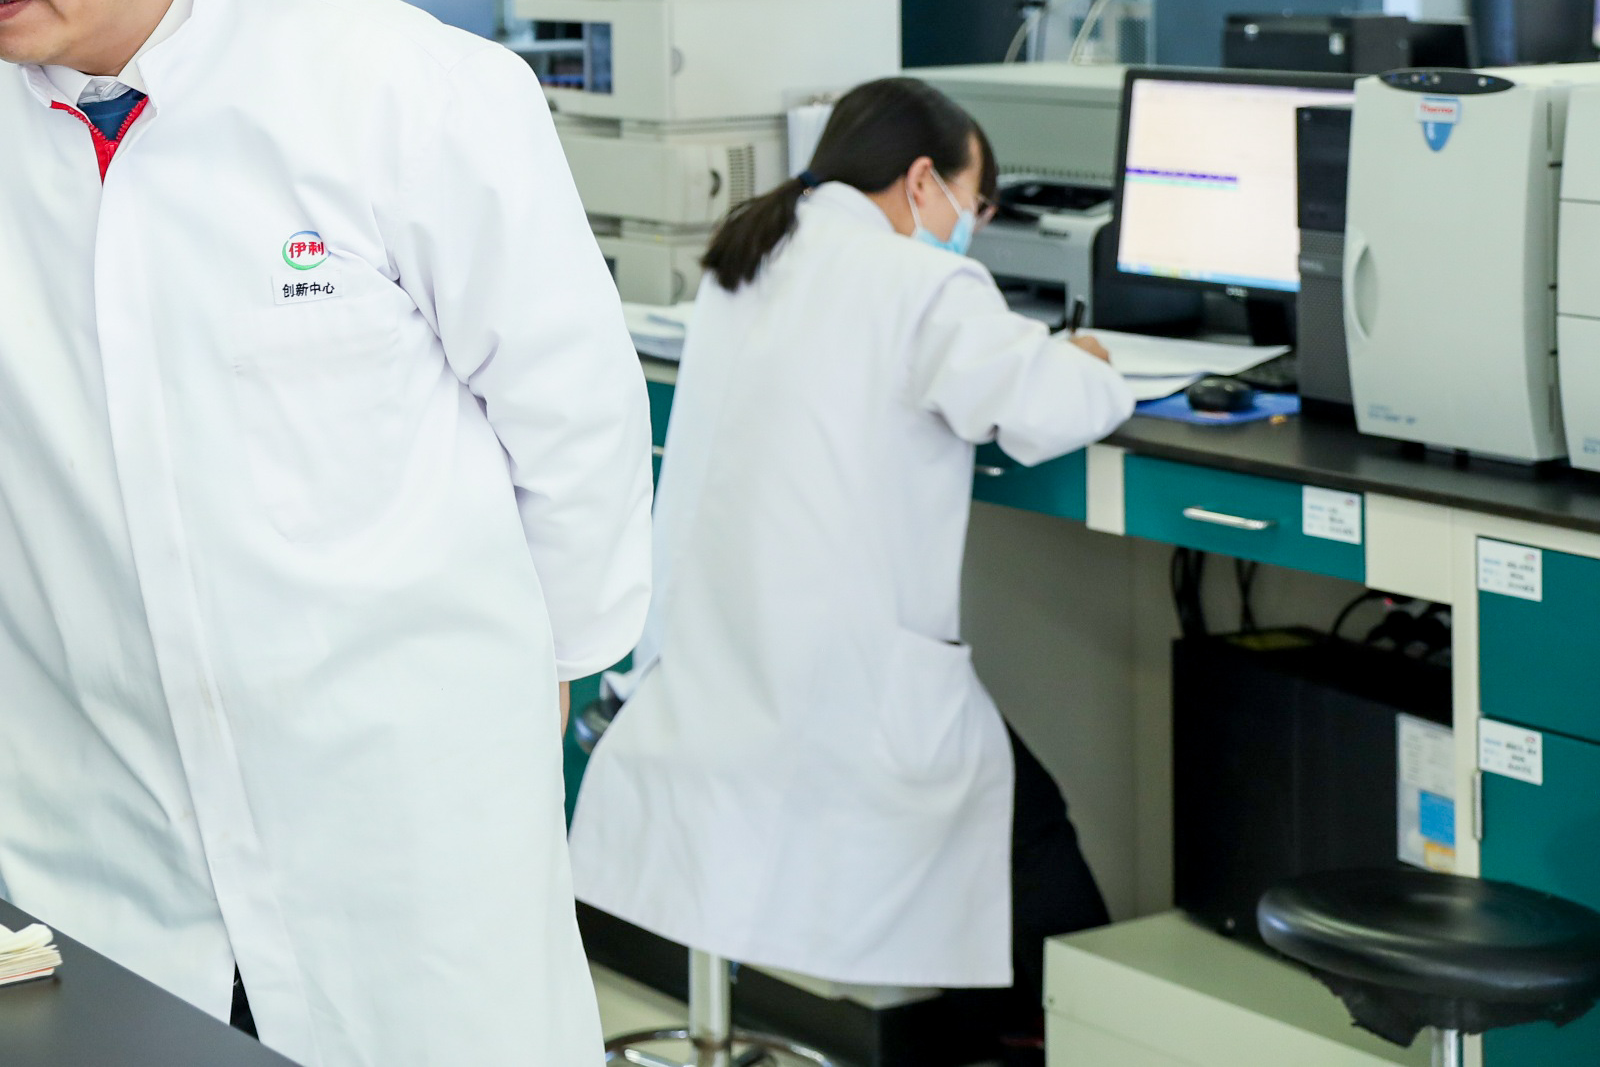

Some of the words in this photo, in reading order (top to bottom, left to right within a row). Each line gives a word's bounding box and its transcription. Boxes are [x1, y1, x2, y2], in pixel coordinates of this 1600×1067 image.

[289, 242, 325, 258] 伊利
[283, 282, 335, 298] 创新中心
